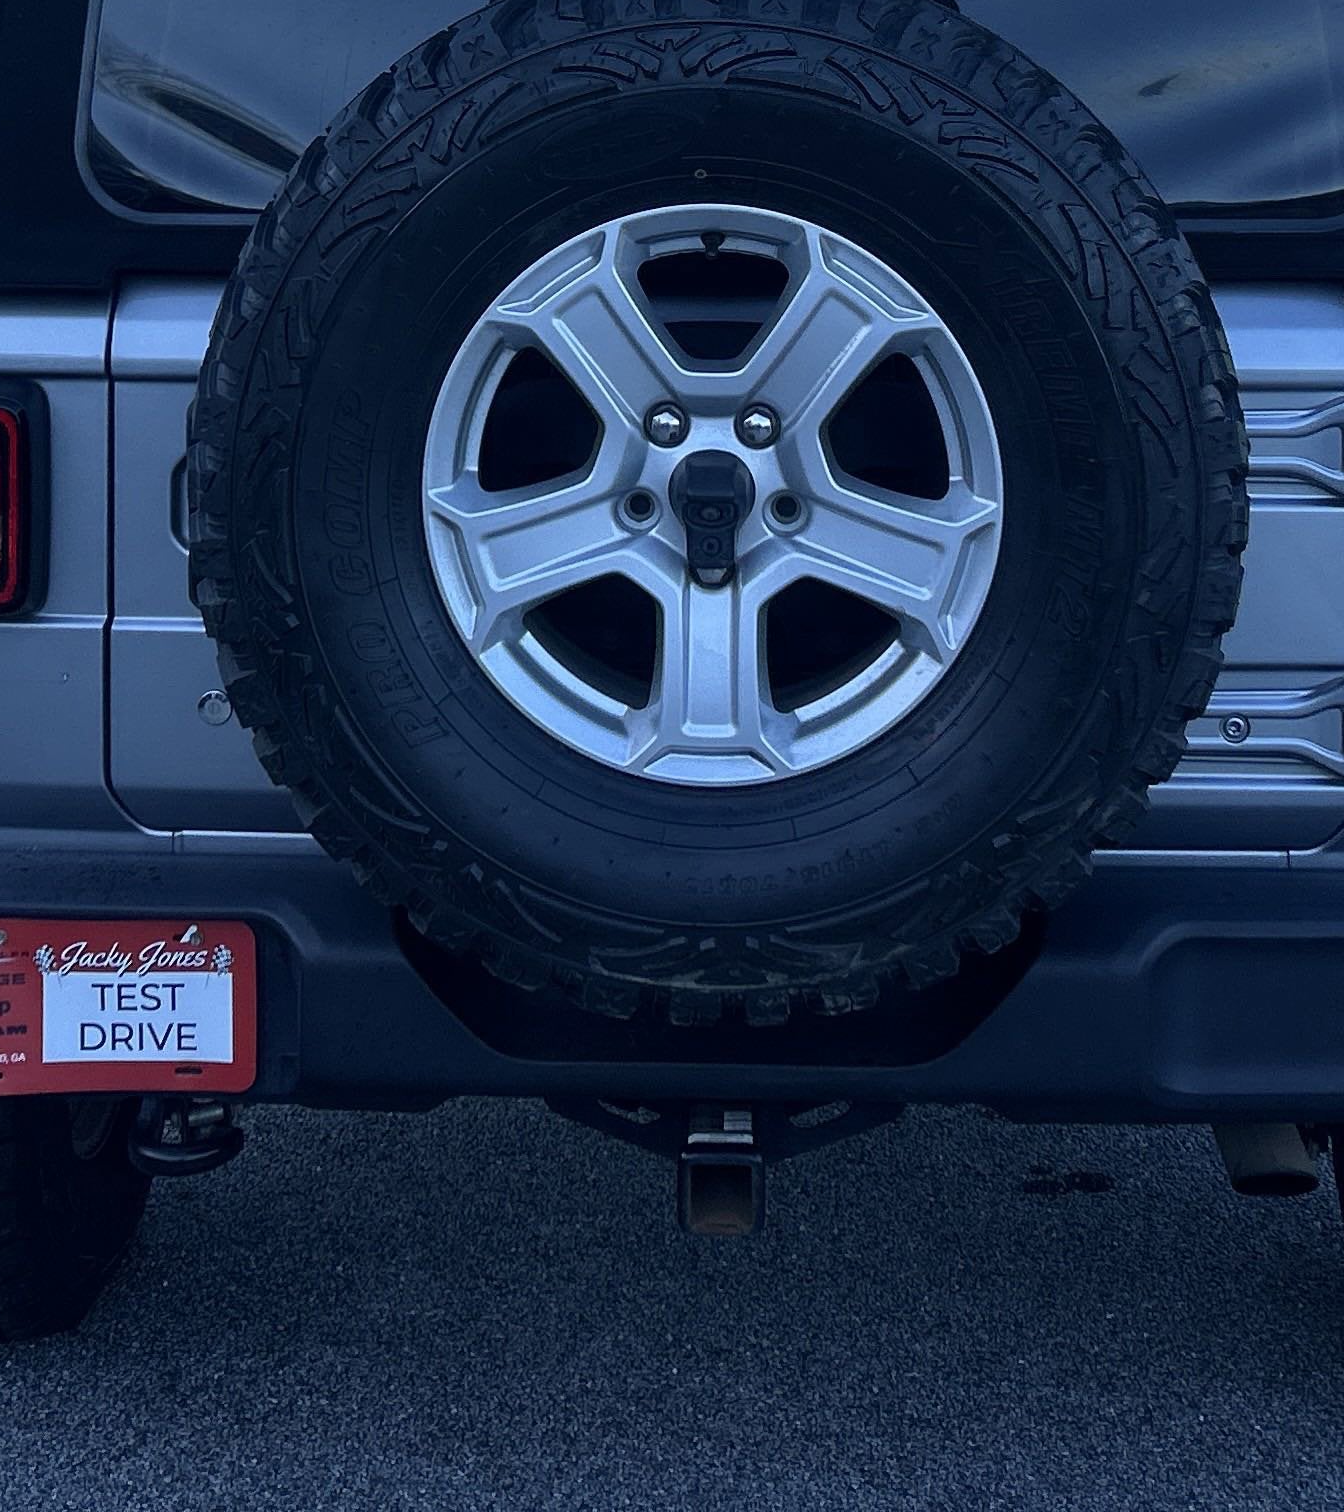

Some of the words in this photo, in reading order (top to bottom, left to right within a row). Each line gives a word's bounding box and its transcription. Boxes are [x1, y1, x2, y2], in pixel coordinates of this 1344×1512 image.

[56, 941, 133, 977] Jacky
[136, 941, 208, 977] Jones
[91, 983, 185, 1011] TEST
[79, 1022, 198, 1051] DRIVE
[10, 1052, 26, 1063] GA
